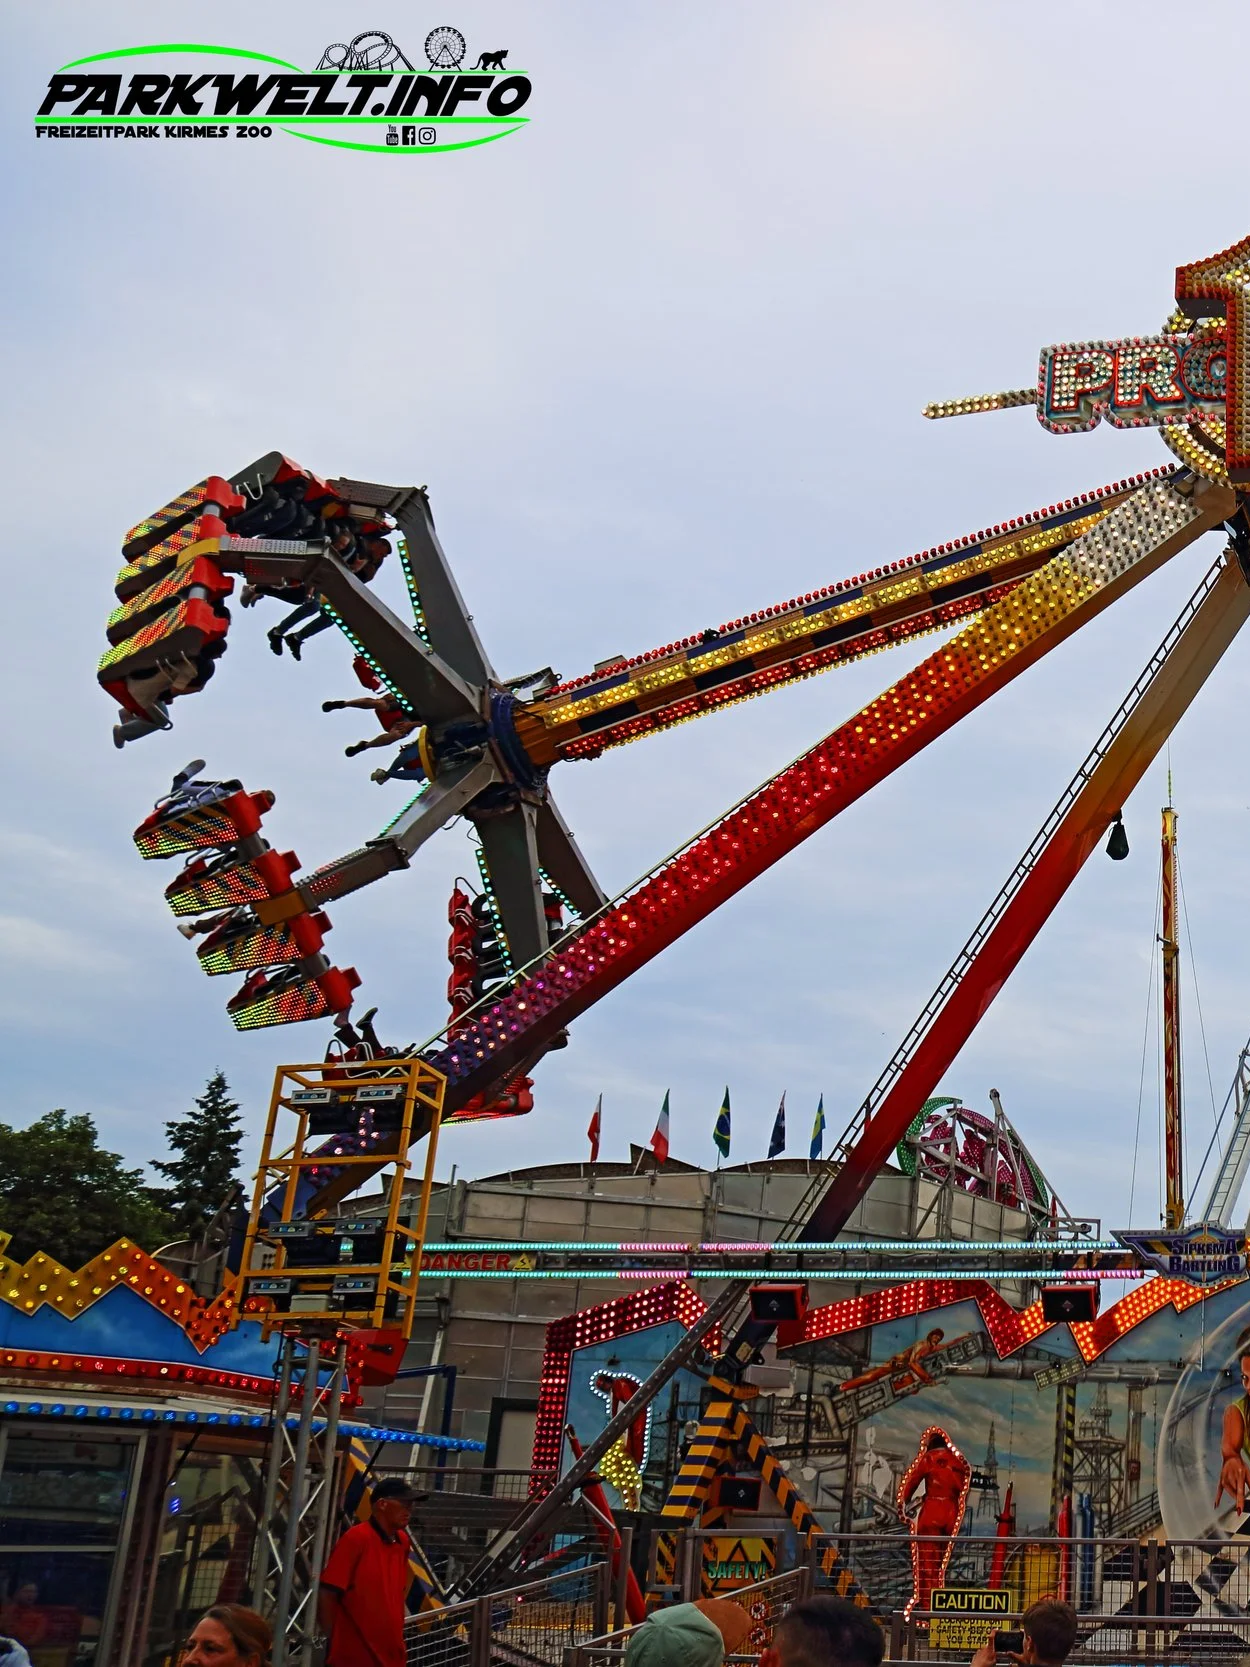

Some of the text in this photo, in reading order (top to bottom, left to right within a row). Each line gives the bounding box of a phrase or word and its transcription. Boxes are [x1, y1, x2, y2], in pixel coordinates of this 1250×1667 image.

[420, 1253, 511, 1271] DANGER
[707, 1561, 767, 1579] SAFETY!
[935, 1593, 1007, 1610] CAUTION
[966, 1636, 988, 1645] STAR
